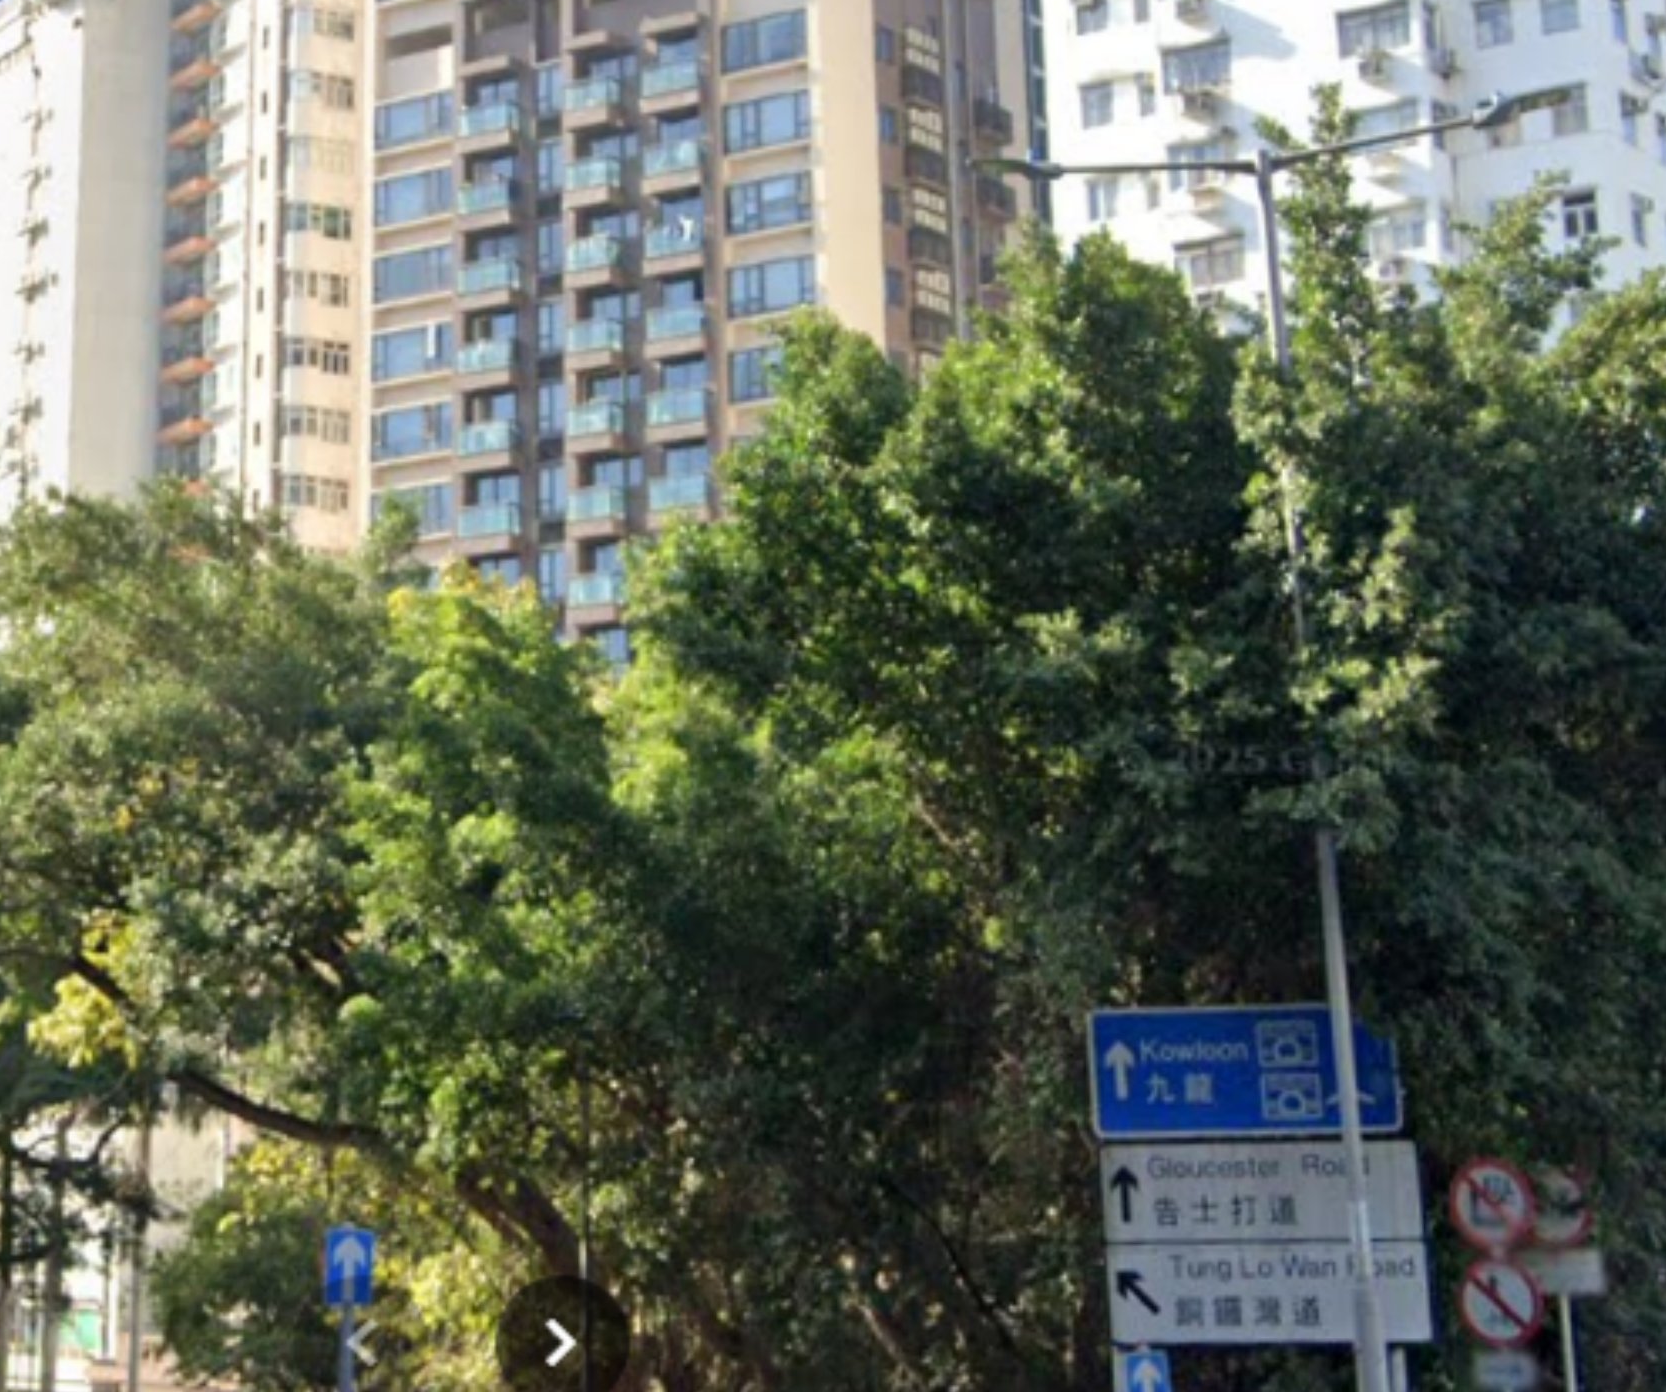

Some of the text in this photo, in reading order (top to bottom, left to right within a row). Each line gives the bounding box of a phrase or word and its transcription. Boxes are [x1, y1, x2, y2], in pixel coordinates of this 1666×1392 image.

[1139, 1039, 1249, 1062] Kowloon
[1146, 1072, 1214, 1104] 九龍
[1146, 1155, 1281, 1179] Gloucester
[1153, 1194, 1297, 1226] 告士打道
[1170, 1255, 1232, 1283] Tung
[1240, 1256, 1274, 1280] Lo
[1282, 1255, 1337, 1279] Wan
[1175, 1295, 1321, 1327] 銅鑼灣道
